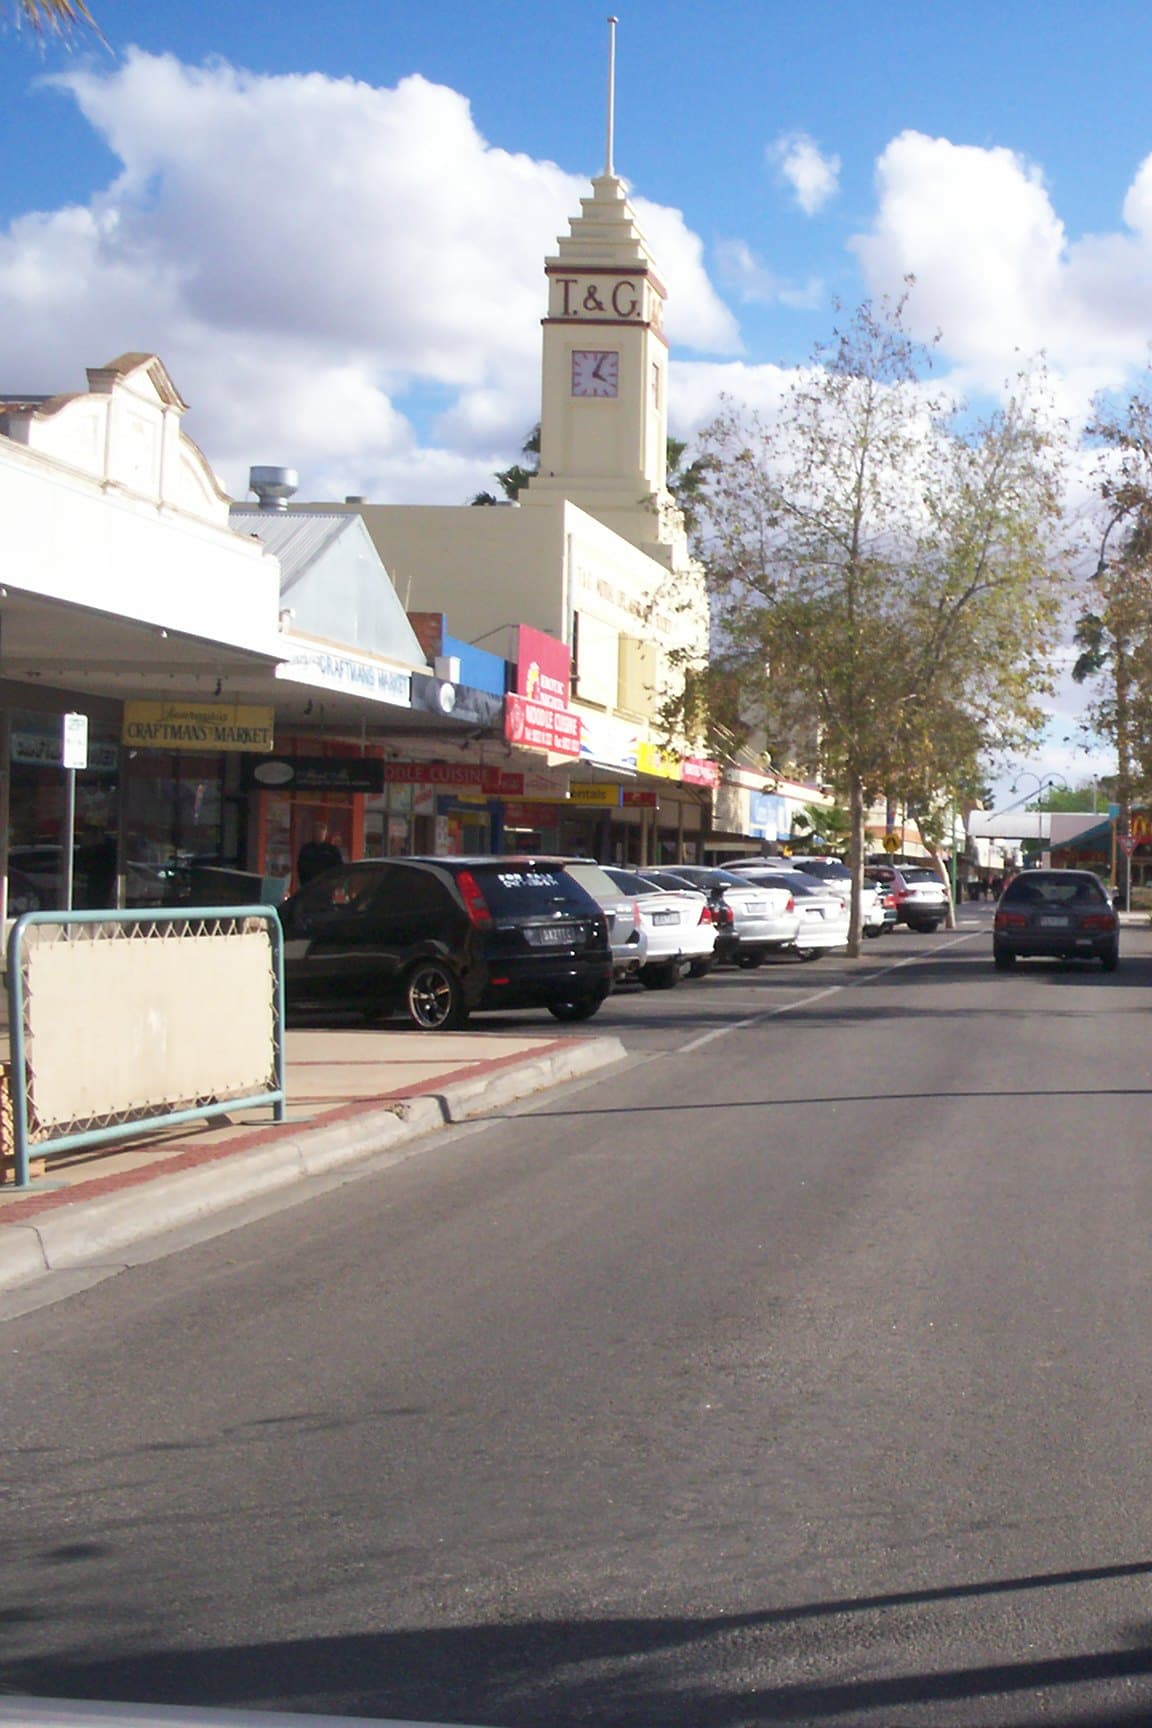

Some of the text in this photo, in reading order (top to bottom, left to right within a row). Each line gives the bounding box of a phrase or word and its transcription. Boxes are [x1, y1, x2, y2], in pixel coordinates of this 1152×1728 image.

[127, 721, 268, 744] CRAFTMANS MARKET
[430, 766, 489, 784] CUISINE
